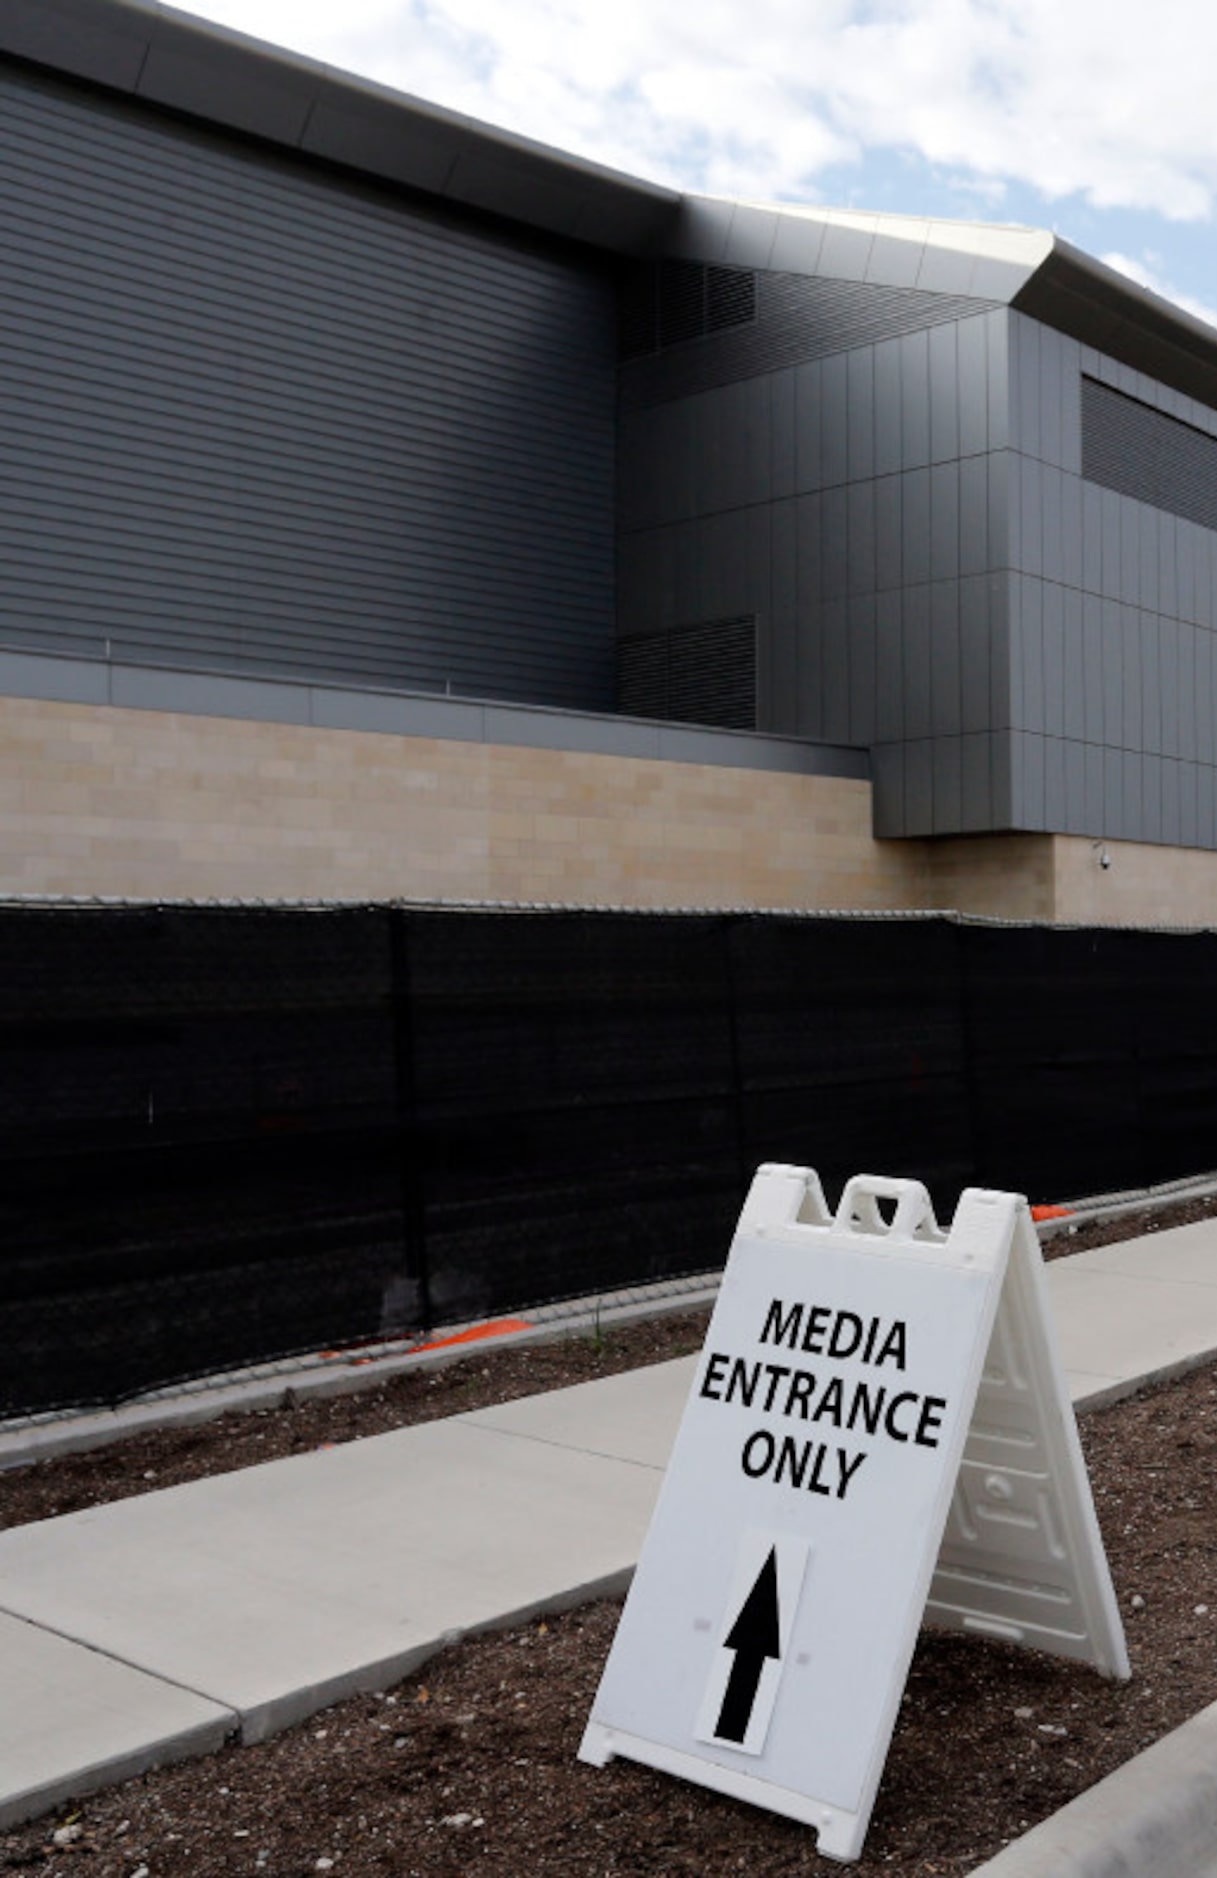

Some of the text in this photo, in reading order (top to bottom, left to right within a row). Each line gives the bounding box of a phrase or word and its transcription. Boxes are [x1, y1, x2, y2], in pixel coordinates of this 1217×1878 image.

[759, 1299, 906, 1372] MEDIA
[699, 1352, 947, 1449] ENTRANCE
[741, 1429, 868, 1500] ONLY
